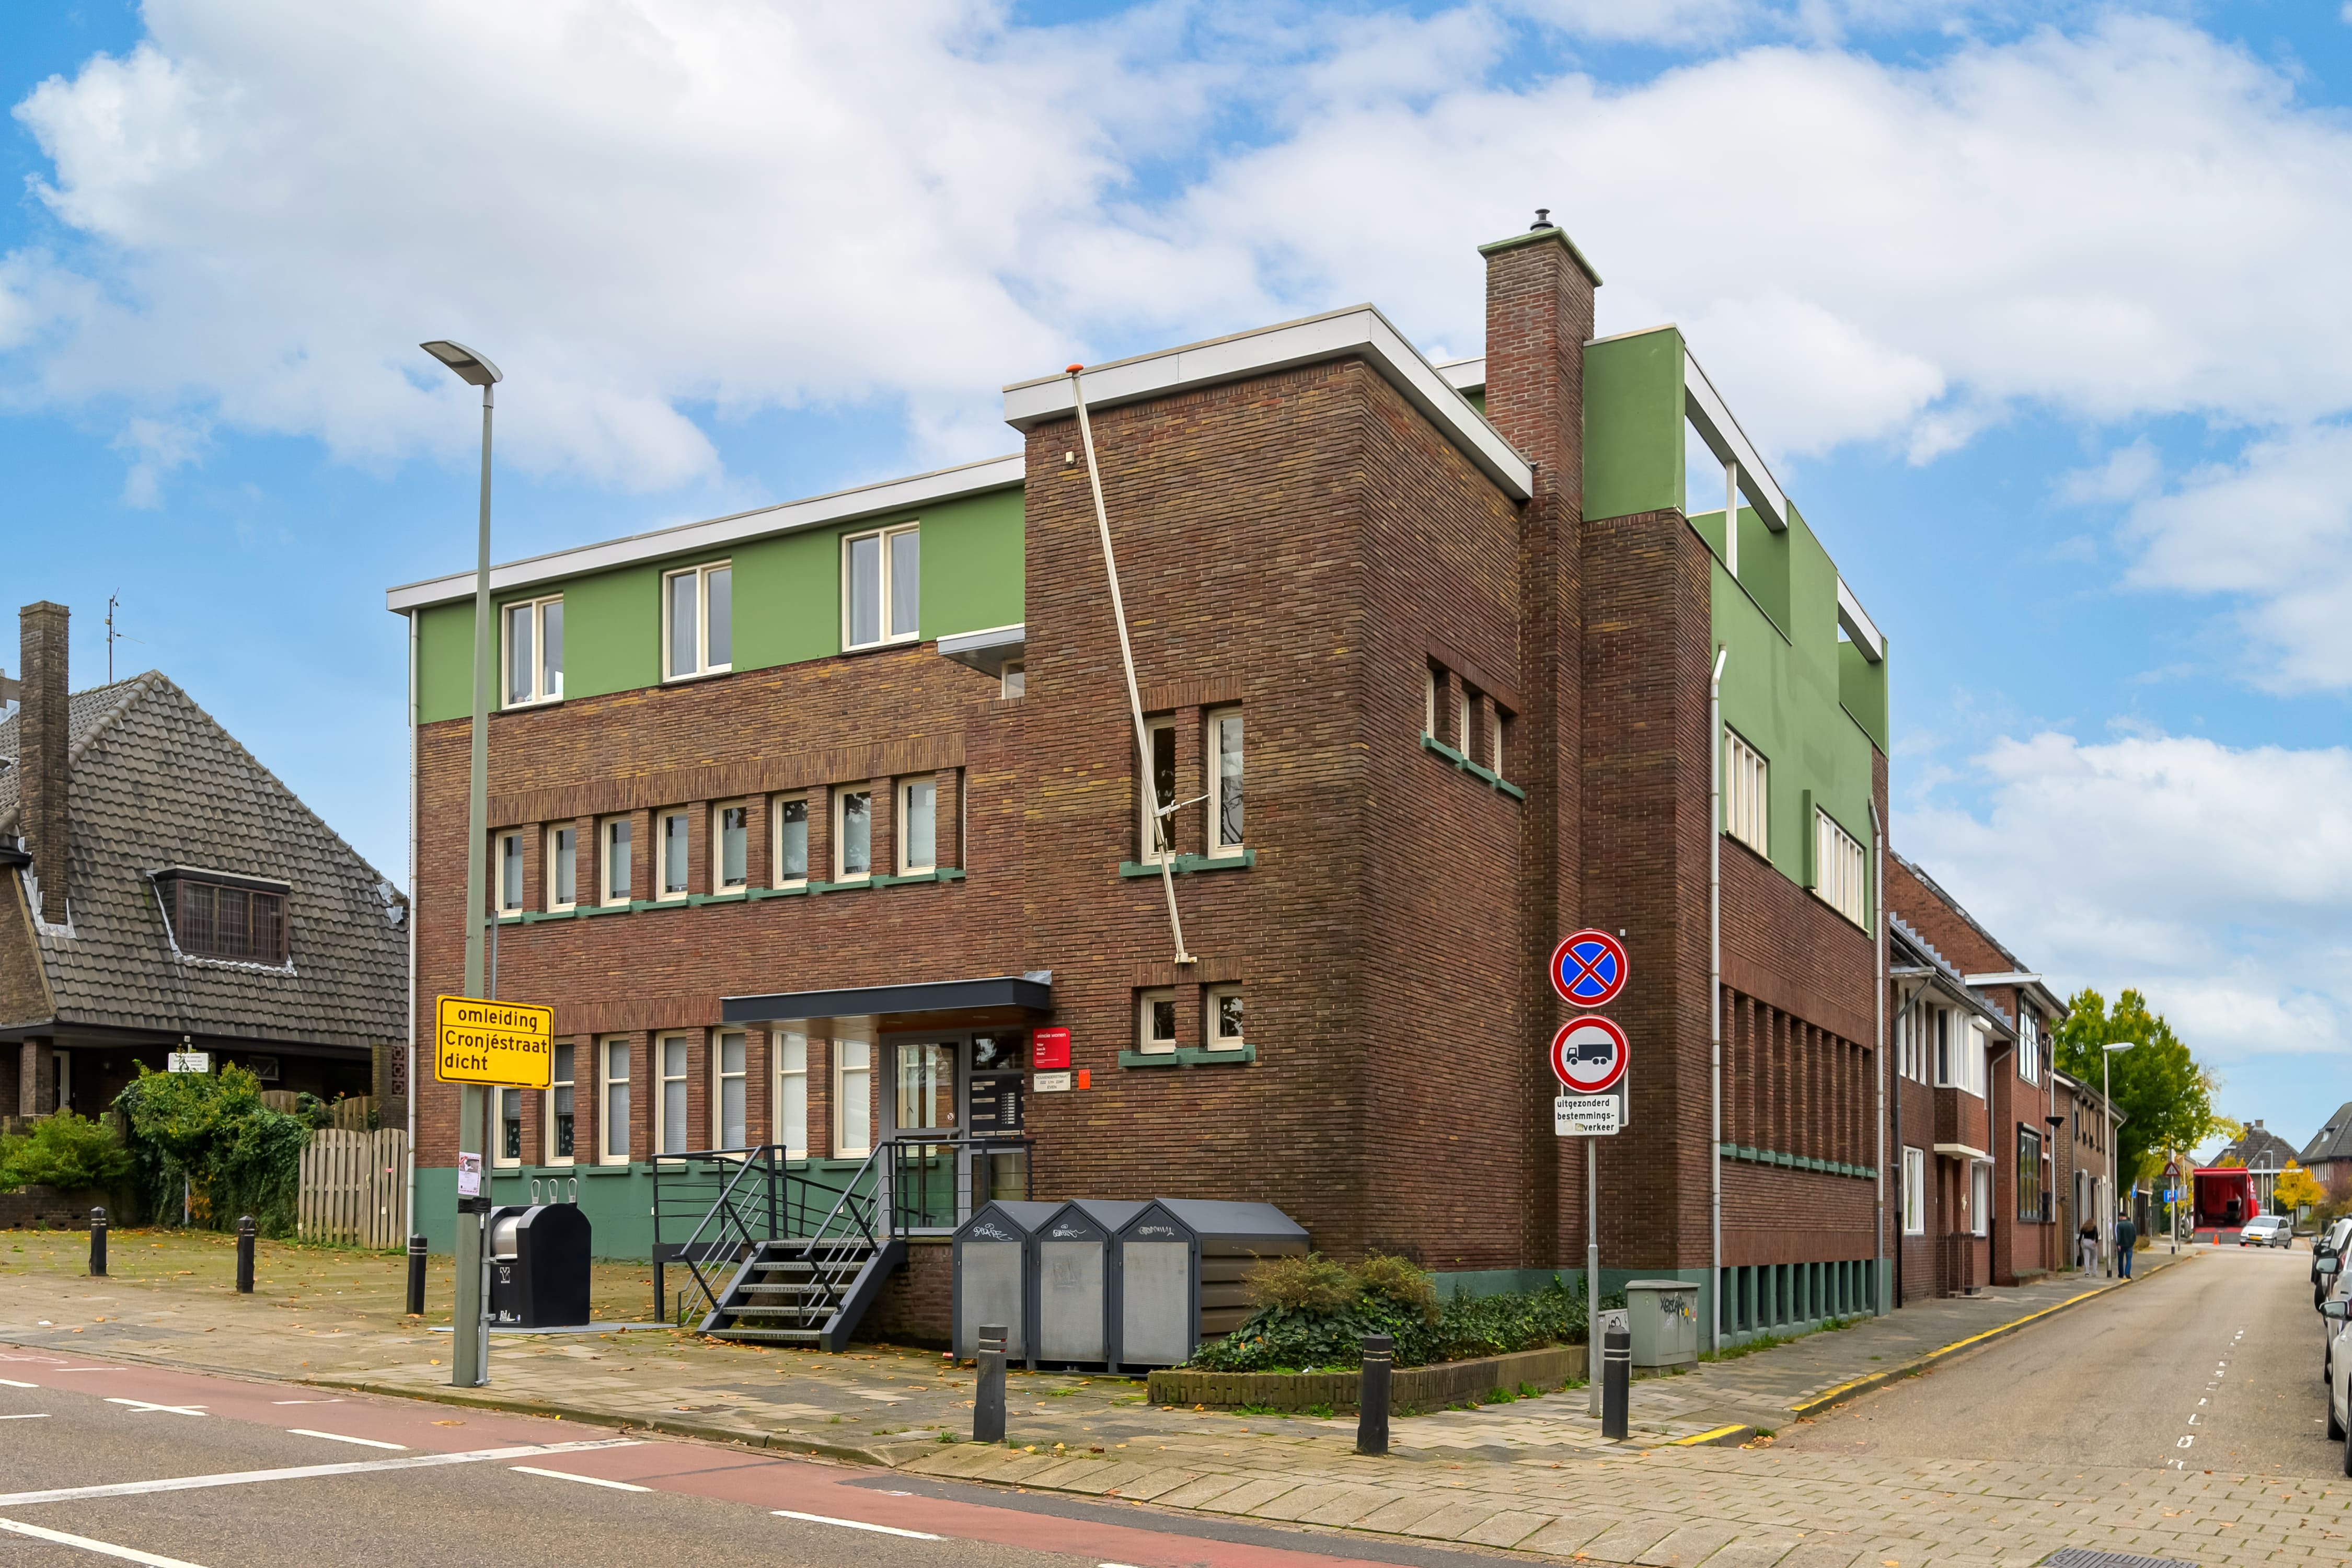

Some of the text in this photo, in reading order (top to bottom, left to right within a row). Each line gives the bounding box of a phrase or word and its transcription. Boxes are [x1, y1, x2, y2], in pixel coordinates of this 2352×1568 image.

[458, 1008, 537, 1033] omleiding
[445, 1030, 547, 1054] Cronjéstraat
[445, 1053, 488, 1070] dicht
[1557, 1098, 1610, 1110] uitgezonderd
[1557, 1111, 1615, 1122] bestemmings-
[1584, 1123, 1615, 1131] verkeer
